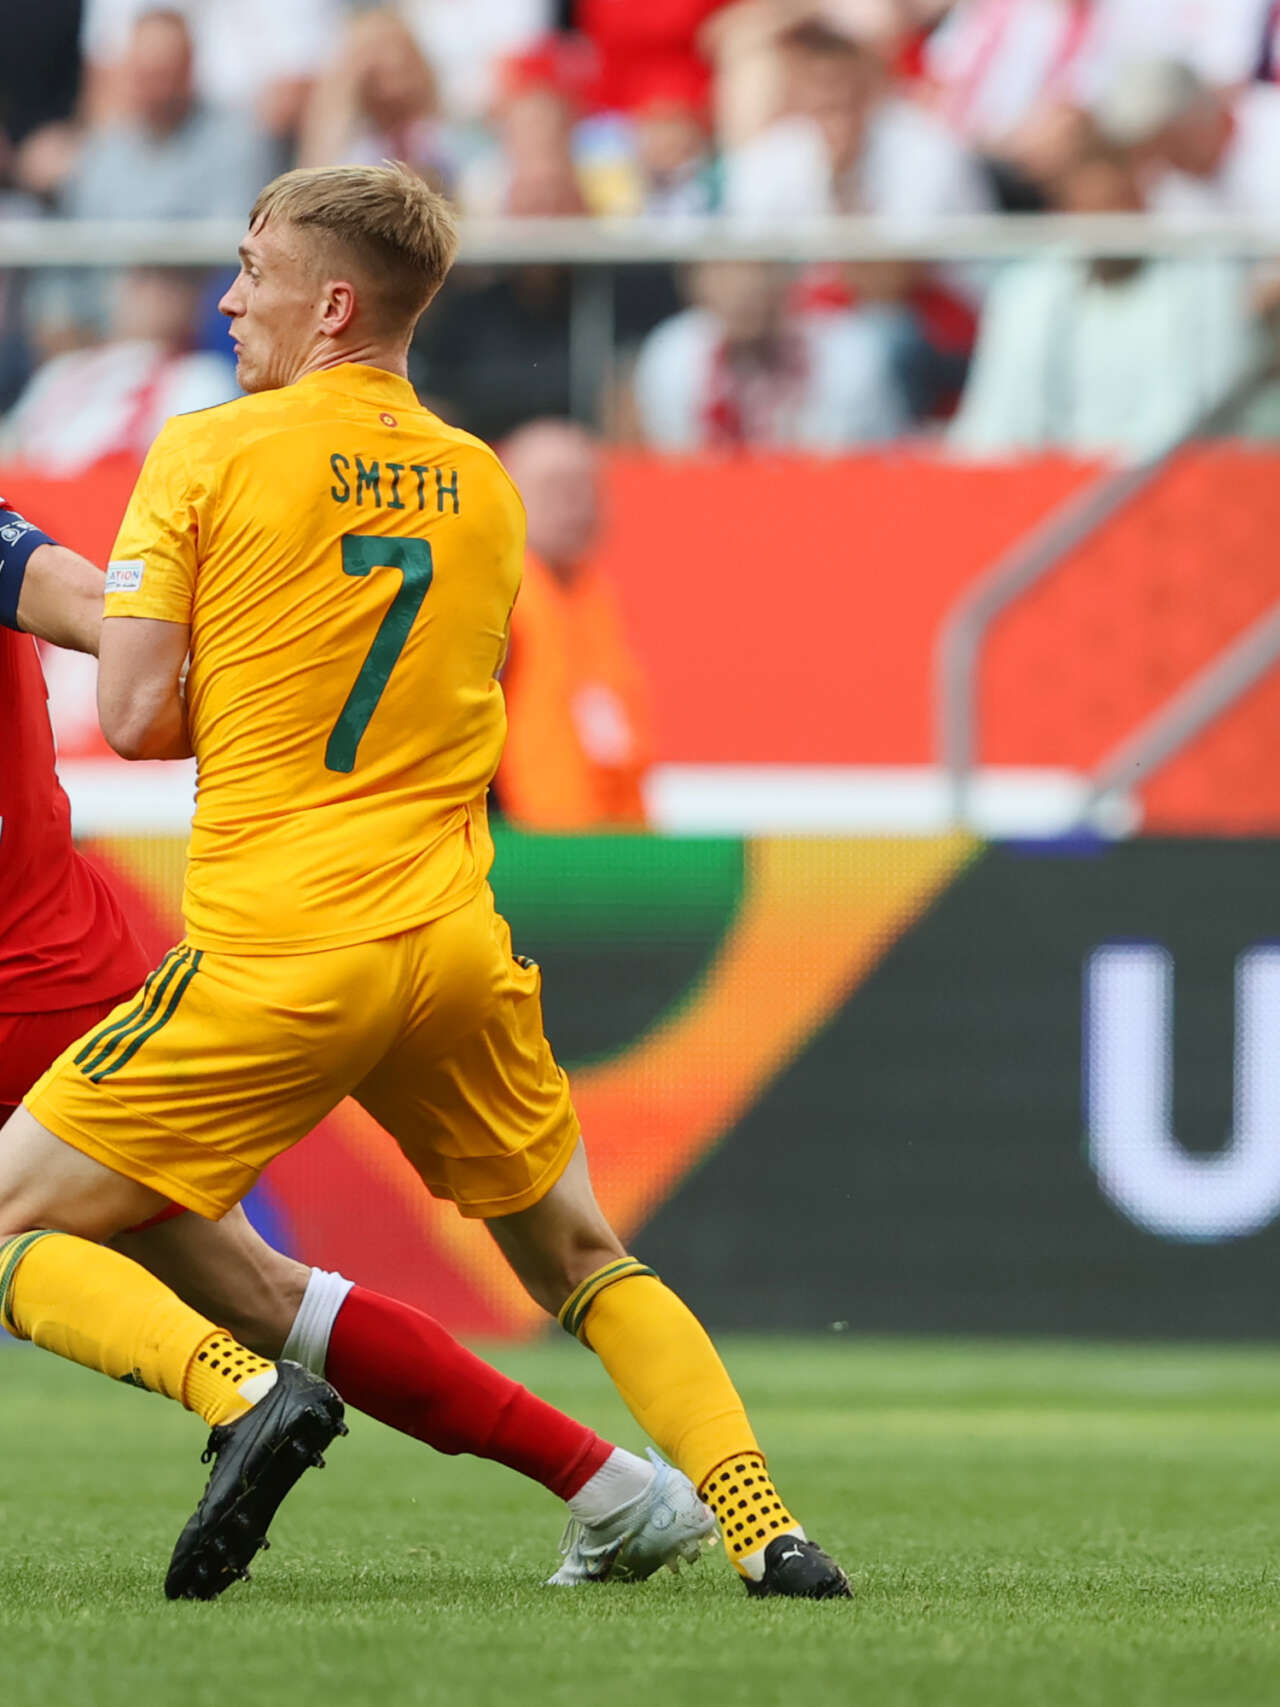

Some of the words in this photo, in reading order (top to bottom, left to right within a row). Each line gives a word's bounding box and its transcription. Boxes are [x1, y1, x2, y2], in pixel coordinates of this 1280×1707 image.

[330, 453, 460, 514] SMITH
[325, 533, 433, 773] 7
[1084, 944, 1280, 1241] U
